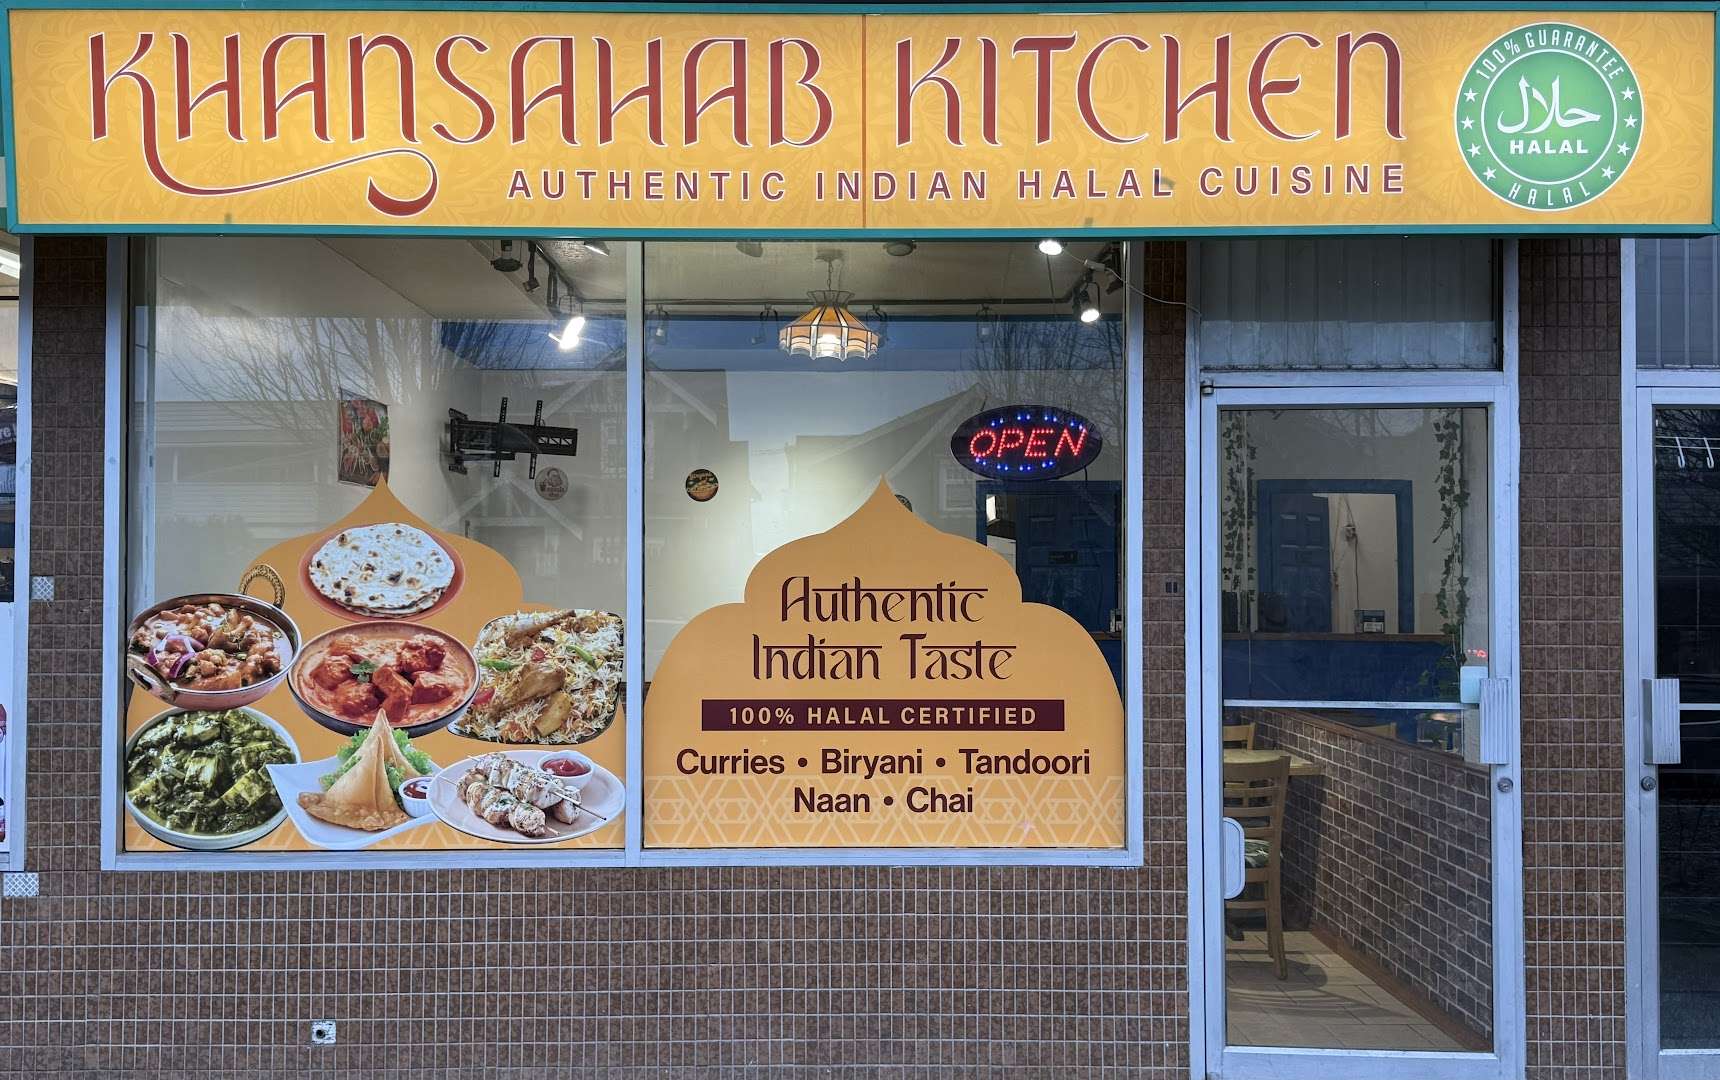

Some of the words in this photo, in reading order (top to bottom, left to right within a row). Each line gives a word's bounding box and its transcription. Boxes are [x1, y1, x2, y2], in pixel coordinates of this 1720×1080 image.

[1476, 38, 1521, 80] 100%
[1525, 29, 1624, 80] GUARANTEE
[1497, 75, 1602, 134] حلال
[89, 31, 833, 218] KHANSAHAB
[896, 31, 1407, 148] KITCHEN
[1509, 139, 1589, 154] HALAL
[508, 169, 785, 200] AUTHENTIC
[815, 170, 987, 201] INDIAN
[1017, 167, 1173, 199] HALAL
[1199, 163, 1404, 197] CUISINE
[1508, 182, 1591, 206] HALAL
[969, 427, 1089, 458] OPEN
[781, 576, 988, 622] Authentic
[752, 633, 882, 680] Indian
[899, 633, 1017, 680] Taste
[728, 707, 795, 725] 100%
[807, 707, 890, 725] HALAL
[901, 707, 1037, 725] CERTIFIED
[676, 748, 785, 775] Curries
[821, 748, 923, 780] Biryani
[958, 748, 1091, 775] Tandoori
[794, 786, 871, 813] Naan
[906, 786, 974, 813] Chai
